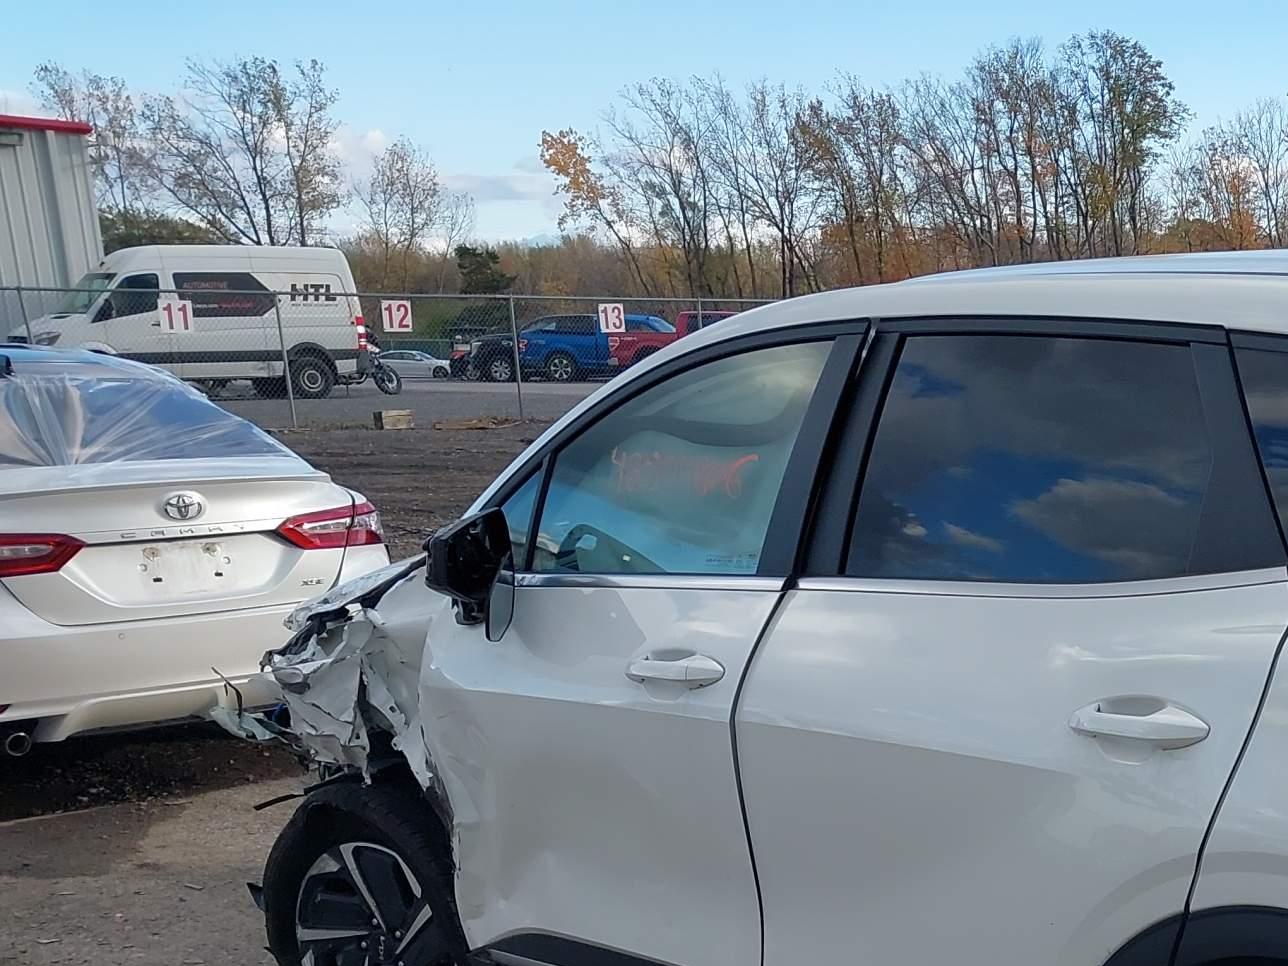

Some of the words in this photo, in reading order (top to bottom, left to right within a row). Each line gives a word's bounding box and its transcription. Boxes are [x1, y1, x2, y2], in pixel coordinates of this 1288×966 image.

[182, 281, 228, 289] AUTOMOTIVE
[162, 302, 189, 330] 11
[383, 303, 411, 329] 12
[600, 306, 623, 330] 13
